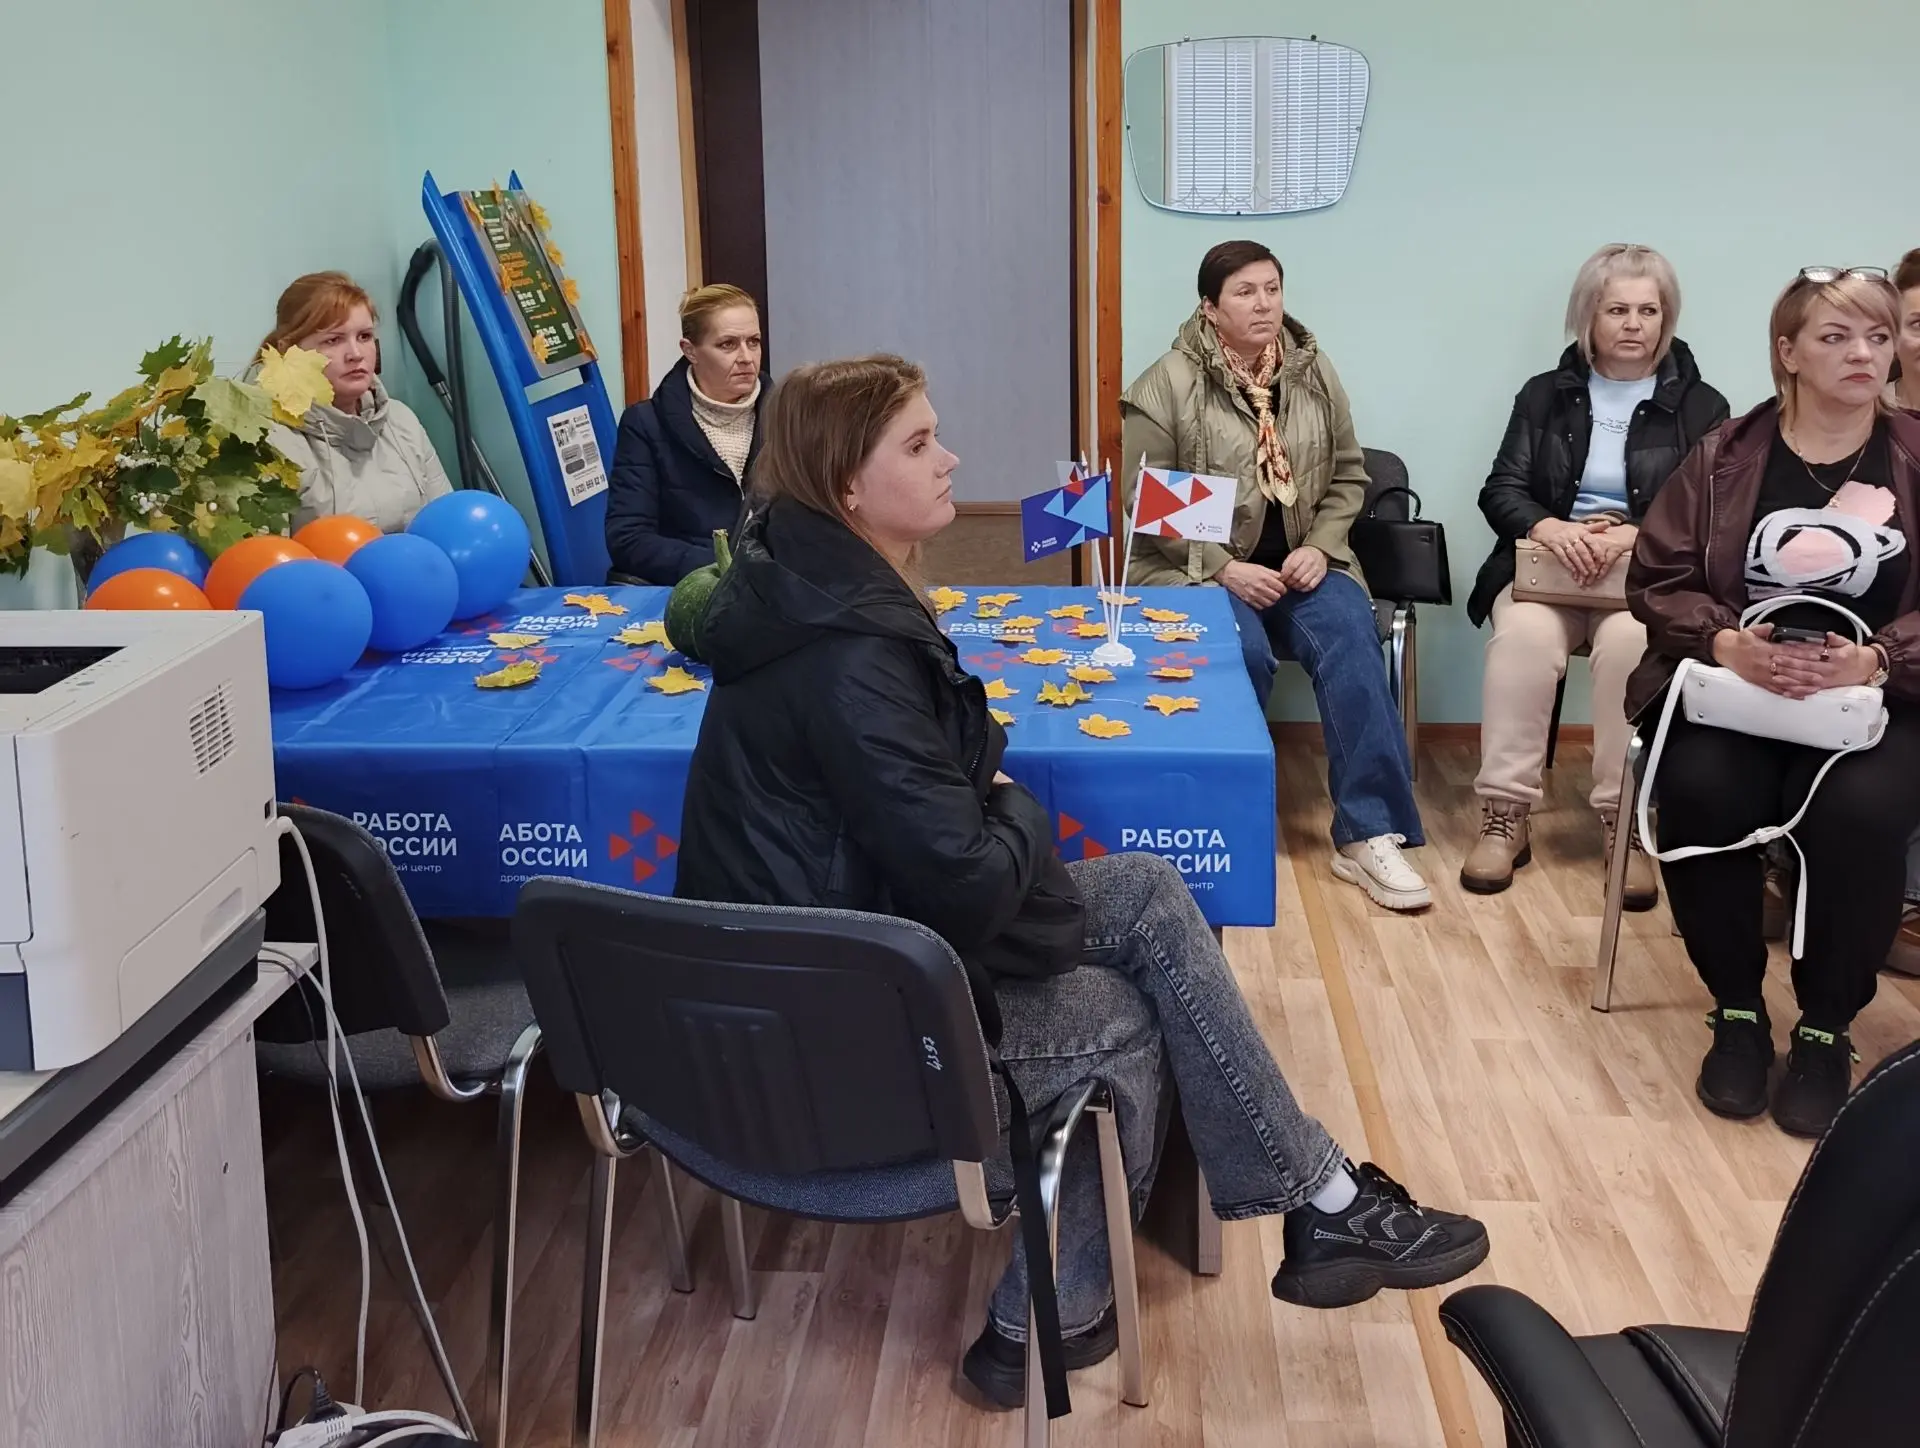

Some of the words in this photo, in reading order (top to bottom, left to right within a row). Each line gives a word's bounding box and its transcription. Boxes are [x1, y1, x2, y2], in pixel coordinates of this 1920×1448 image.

[513, 620, 599, 631] РОССИИ
[520, 615, 598, 624] РАБОТА
[401, 649, 493, 658] РОССИИ
[352, 811, 453, 832] РАБОТА
[499, 822, 583, 843] АБОТА
[1121, 828, 1226, 849] РАБОТА
[374, 836, 457, 856] ОССИИ
[501, 846, 588, 868] ОССИИ
[1161, 853, 1231, 874] СИИ
[410, 864, 442, 873] центр
